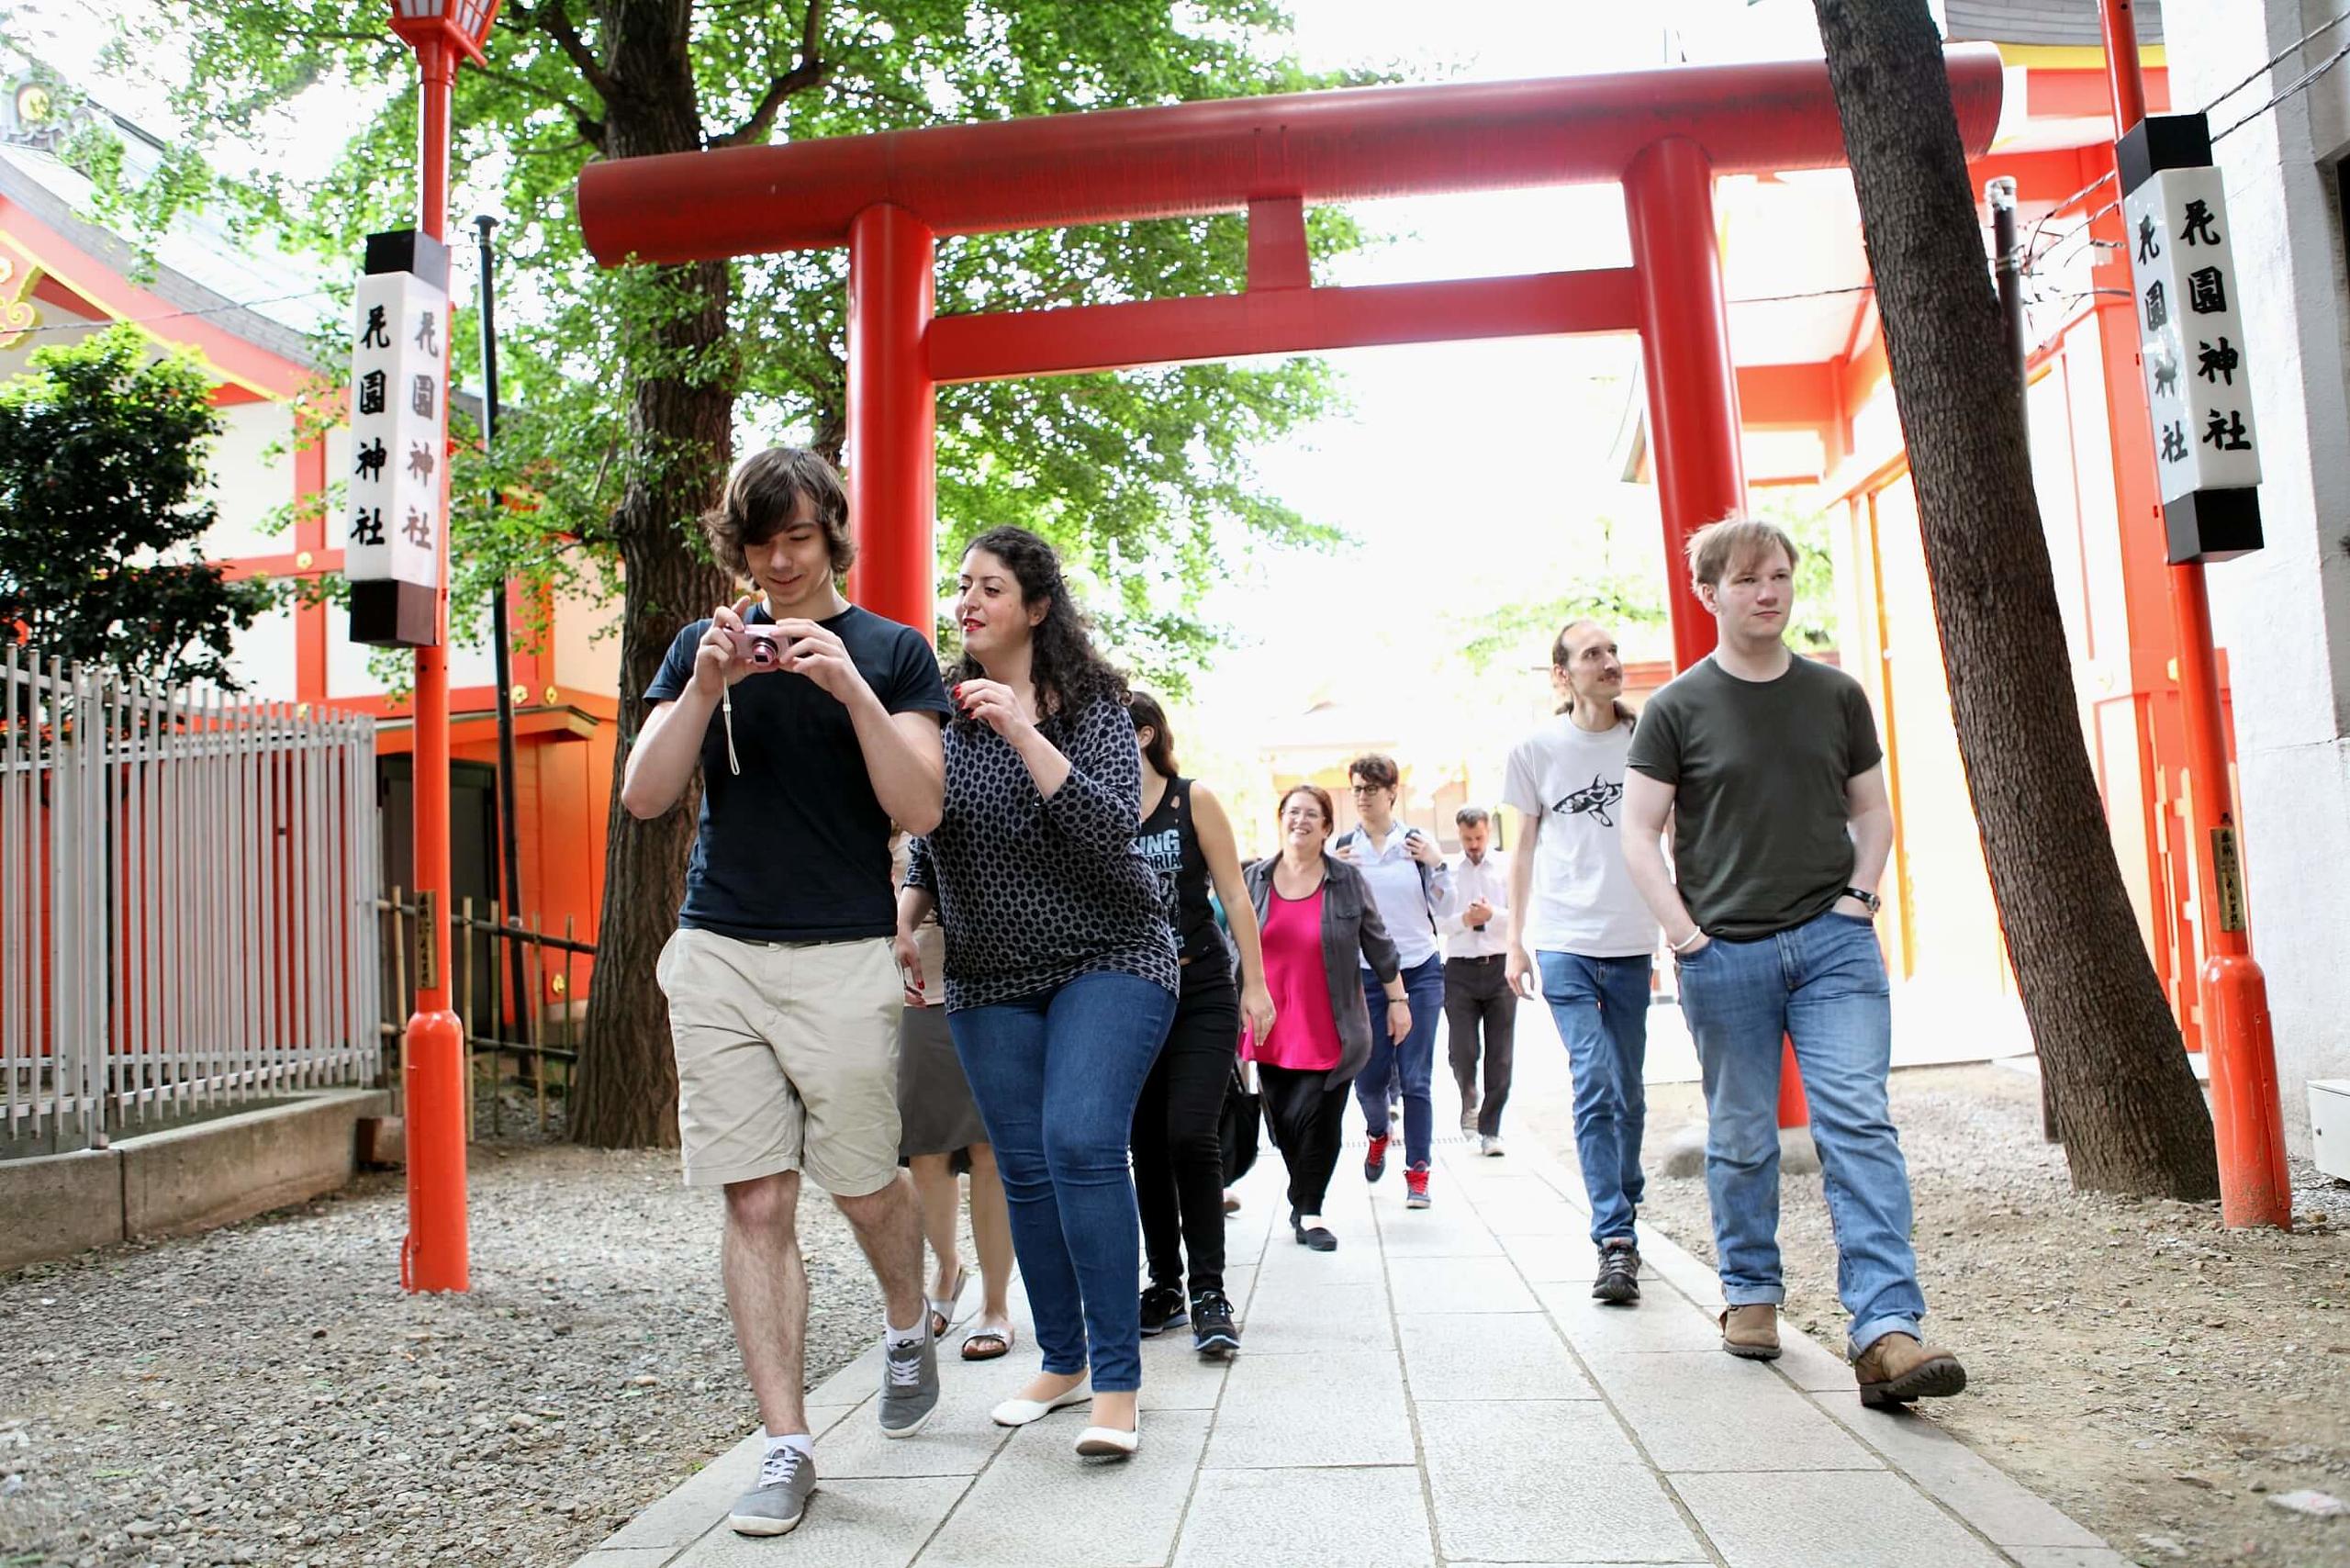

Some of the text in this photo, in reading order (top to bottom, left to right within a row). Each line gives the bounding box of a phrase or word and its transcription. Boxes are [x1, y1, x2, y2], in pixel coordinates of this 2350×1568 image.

[350, 304, 391, 546] 花園神社
[401, 311, 439, 551] 花園神社
[2179, 199, 2252, 451] 花園神社
[1130, 829, 1181, 855] ING
